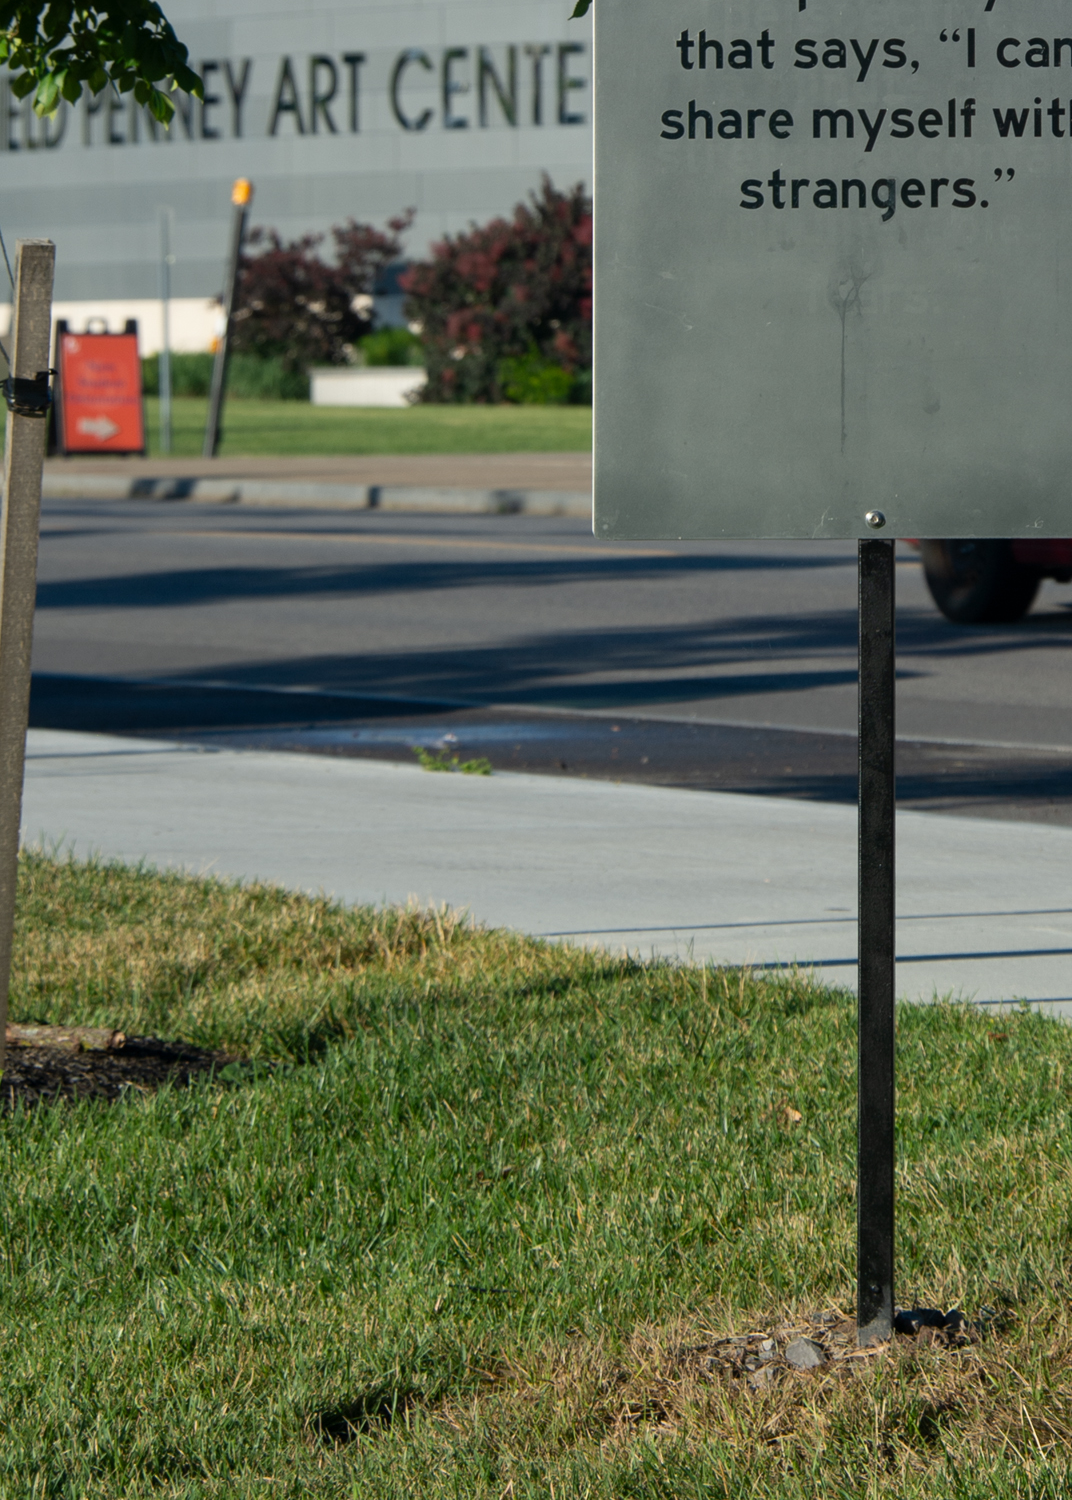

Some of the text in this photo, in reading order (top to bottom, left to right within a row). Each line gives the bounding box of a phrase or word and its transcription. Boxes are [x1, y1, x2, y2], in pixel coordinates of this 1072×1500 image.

[676, 28, 776, 70] that
[793, 37, 920, 83] says,
[938, 27, 977, 68] “I
[268, 51, 367, 138] ART
[659, 98, 795, 140] share
[812, 97, 977, 153] myself
[739, 167, 1016, 223] strangers.”
